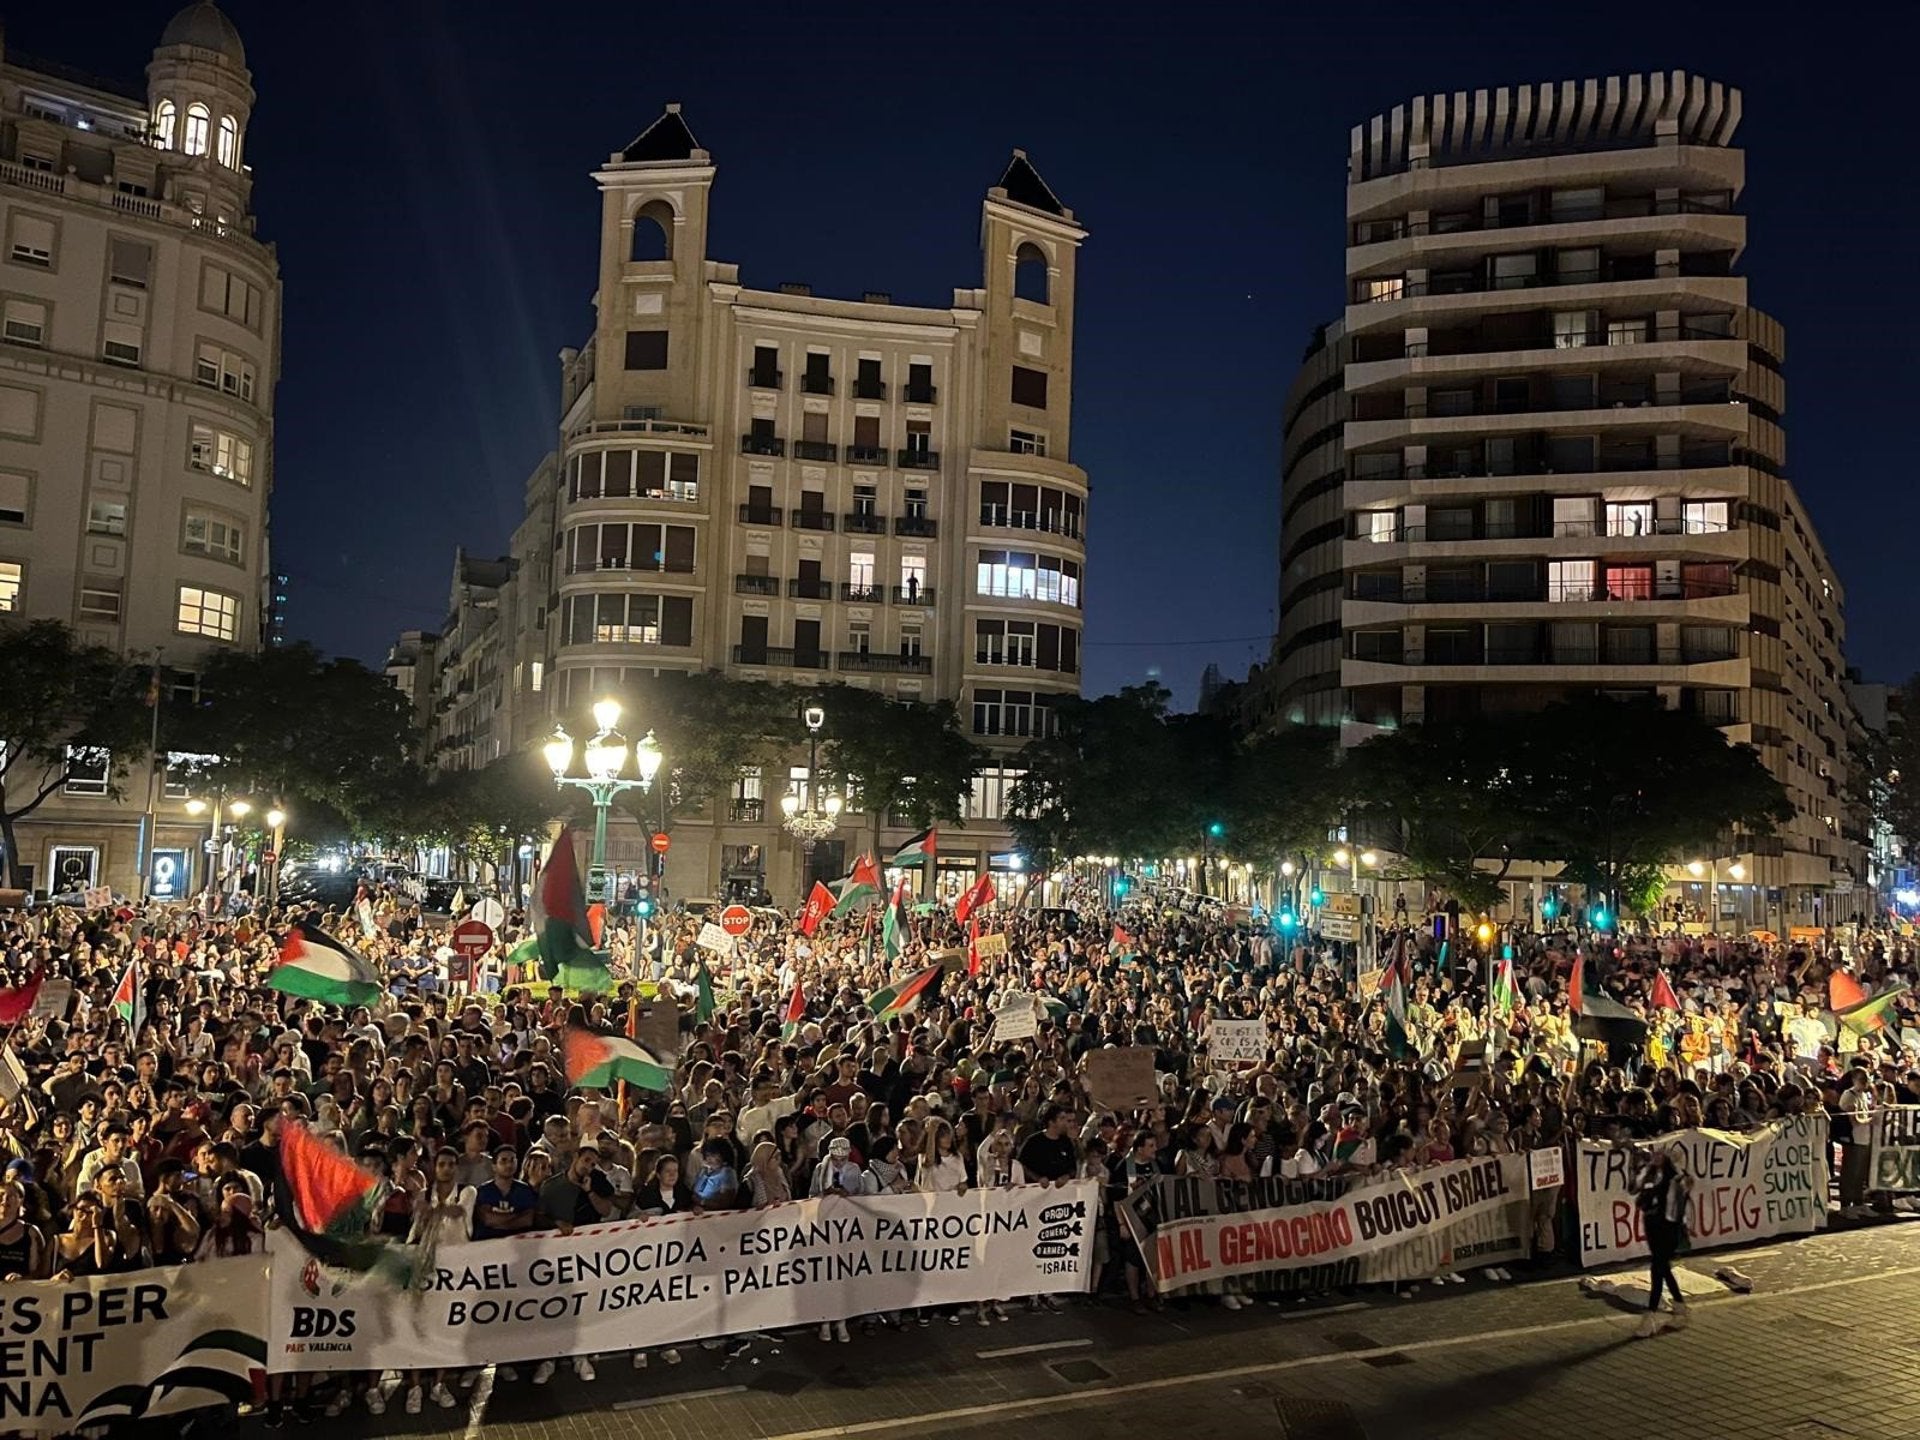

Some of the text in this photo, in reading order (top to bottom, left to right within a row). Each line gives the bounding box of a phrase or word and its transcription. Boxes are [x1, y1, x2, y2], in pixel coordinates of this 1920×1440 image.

[724, 917, 749, 925] STOP
[1045, 1207, 1069, 1220] PROU
[1180, 1228, 1211, 1274] AL
[1219, 1207, 1353, 1265] GENOCIDIO
[1355, 1182, 1441, 1240] BOICOT
[1440, 1160, 1509, 1214] ISRAEL
[1584, 1222, 1607, 1251] EL
[1612, 1184, 1761, 1249] BLQUEIG
[528, 1237, 707, 1287] GENOCIDA
[739, 1217, 863, 1256] ESPANYA
[874, 1208, 1029, 1241] PATROCINA
[0, 1284, 169, 1337] S PER
[447, 1291, 588, 1326] BOICOT
[724, 1250, 873, 1295] PALESTINA
[881, 1245, 971, 1273] LLIURE
[290, 1306, 356, 1338] BDS
